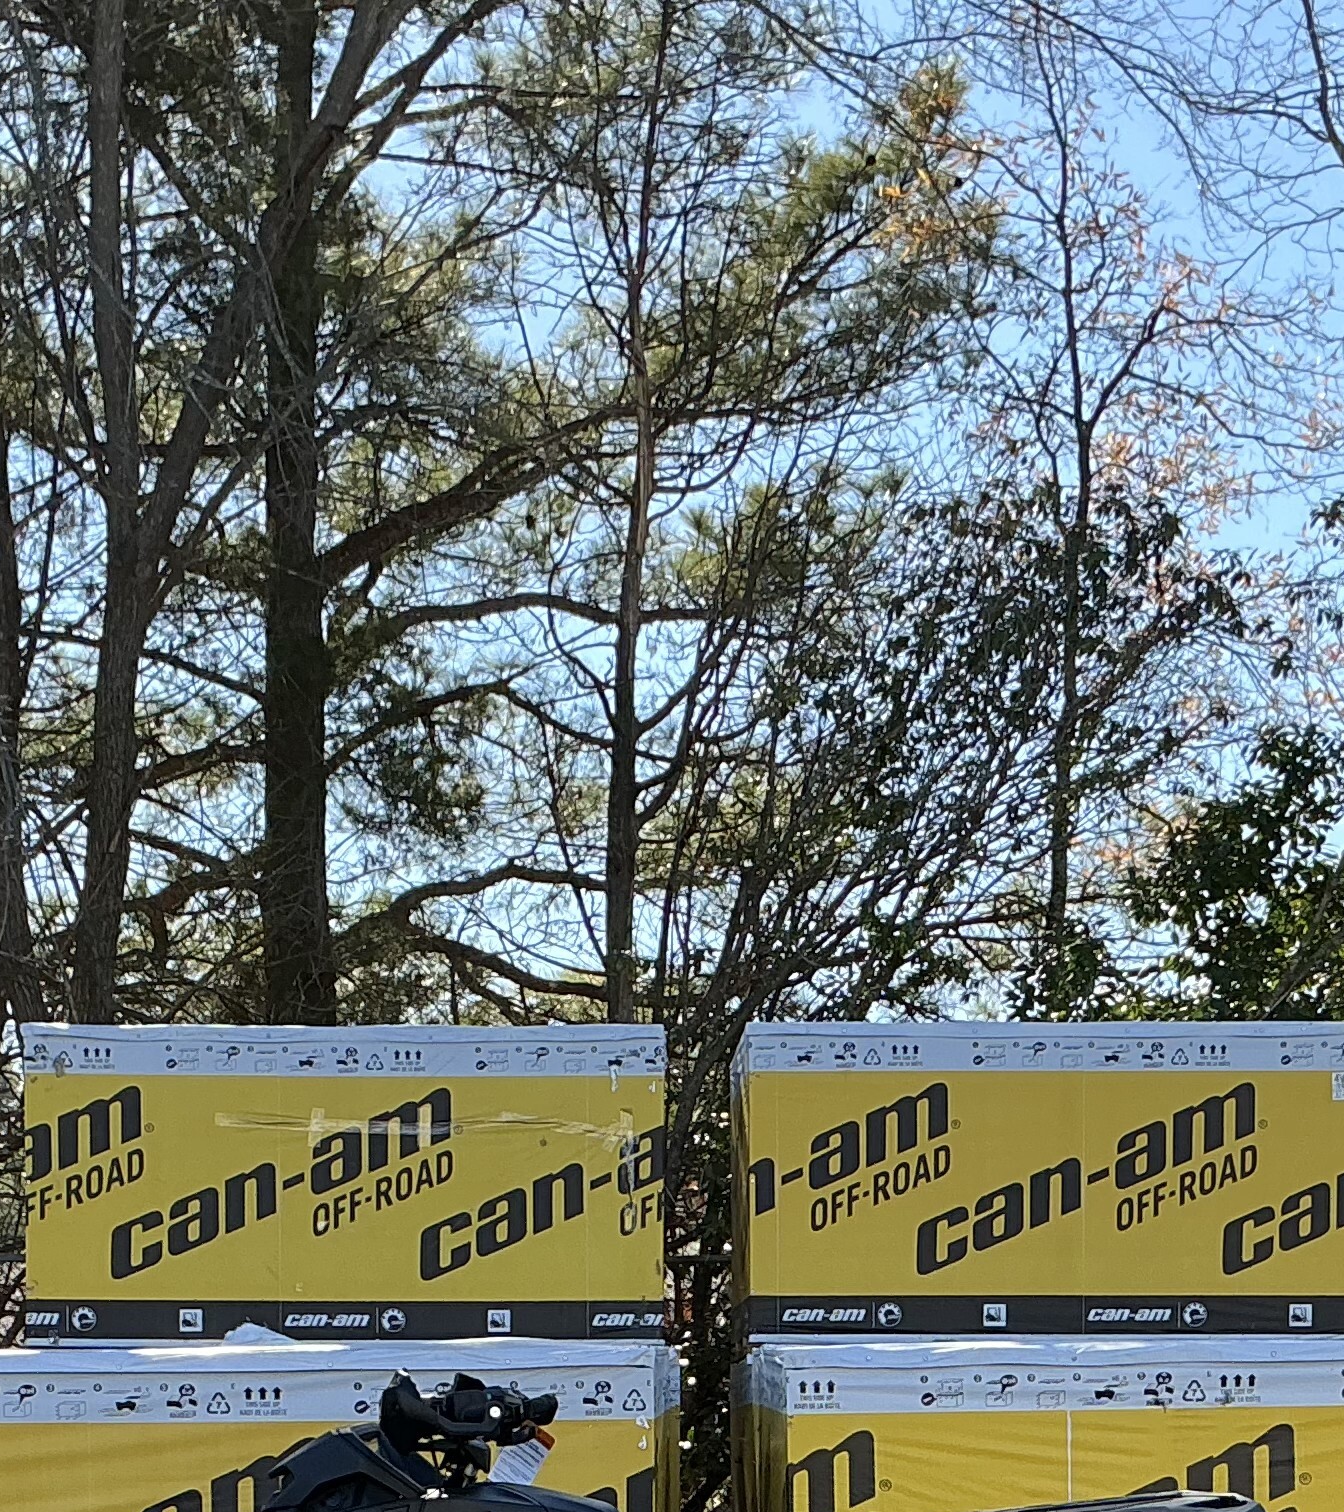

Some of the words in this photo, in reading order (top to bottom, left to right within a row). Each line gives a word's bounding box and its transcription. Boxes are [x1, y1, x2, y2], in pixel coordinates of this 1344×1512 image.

[110, 1087, 452, 1280] can-am
[312, 1150, 454, 1237] OFF-ROAD
[419, 1125, 664, 1281] can-a
[810, 1144, 953, 1232] OFF-ROAD
[915, 1082, 1256, 1276] can-am
[1116, 1144, 1258, 1232] OFF-ROAD
[284, 1312, 371, 1328] can-am
[782, 1304, 867, 1322] can-am
[1087, 1304, 1173, 1322] can-am
